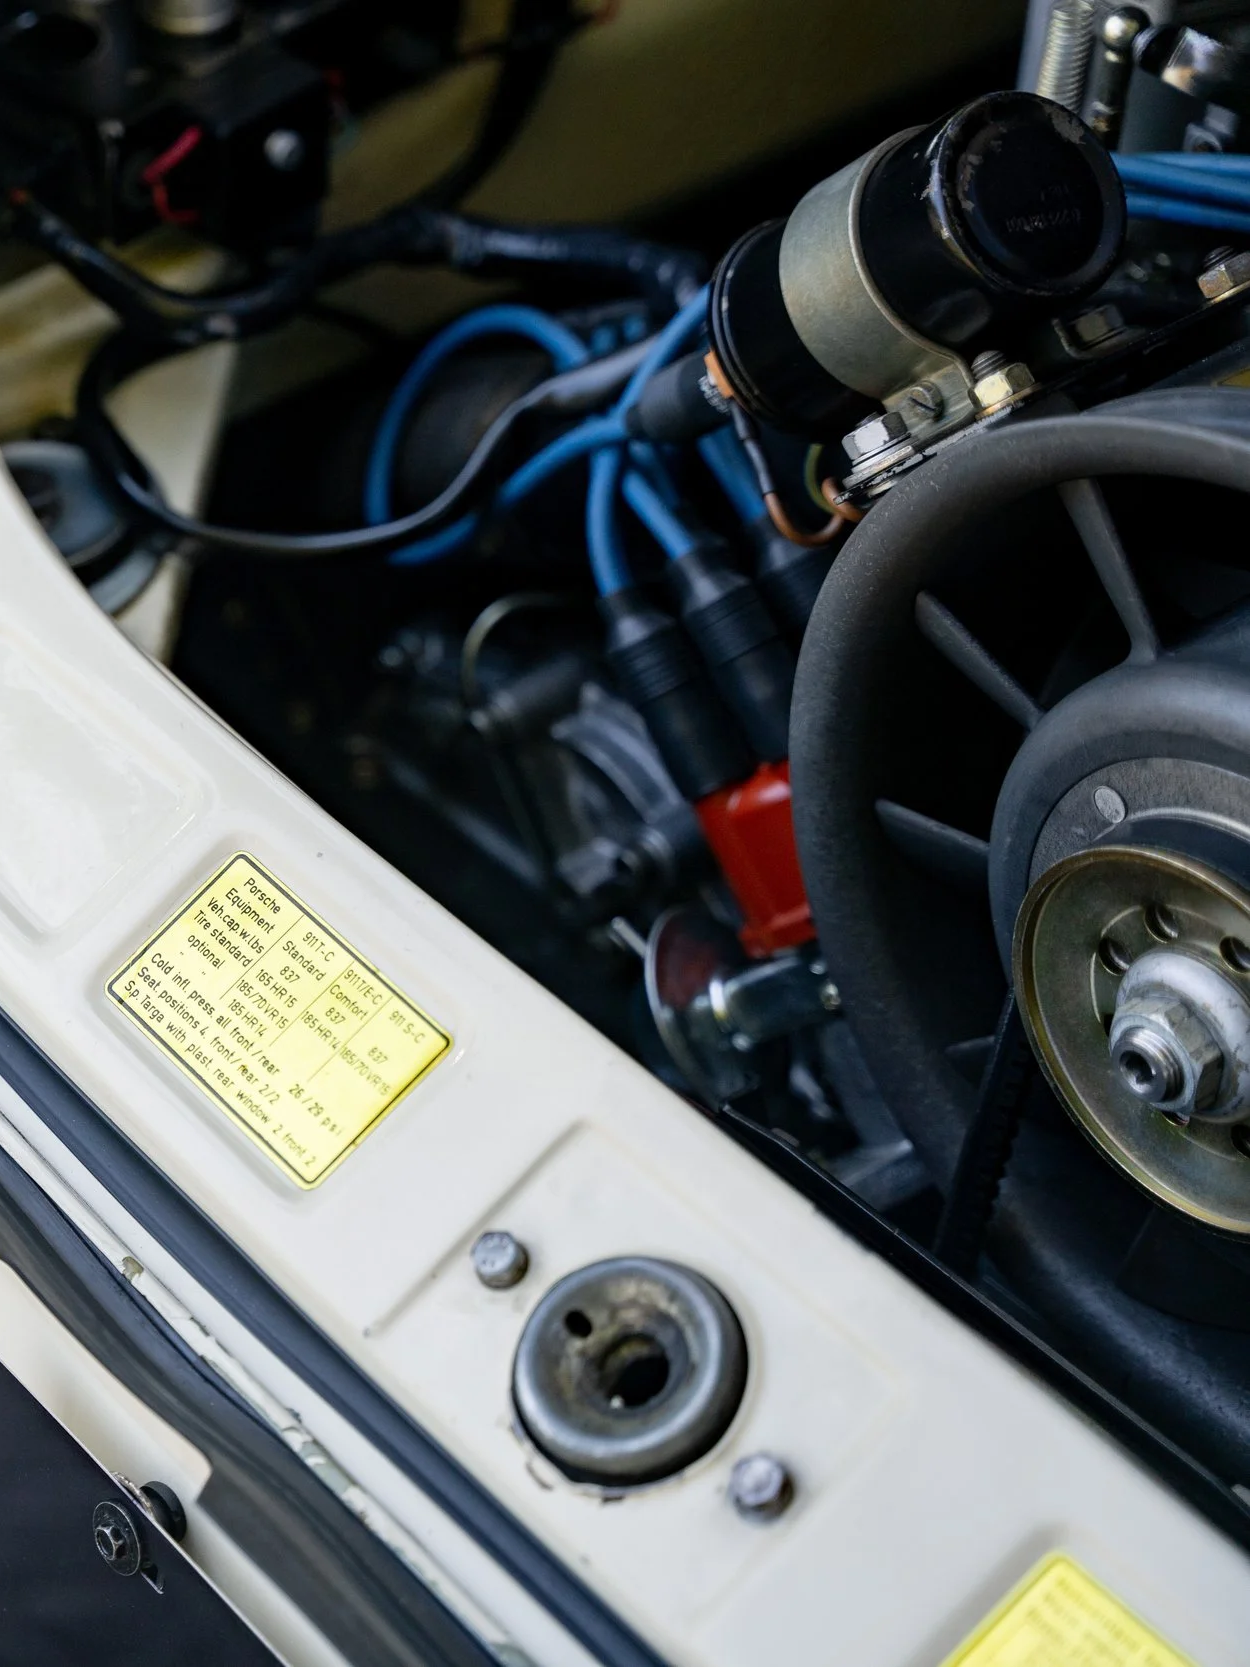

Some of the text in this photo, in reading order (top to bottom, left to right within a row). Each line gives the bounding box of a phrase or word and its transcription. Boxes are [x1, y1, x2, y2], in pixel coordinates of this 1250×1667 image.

[243, 877, 281, 915] Porsche
[187, 934, 226, 970] optional
[193, 909, 212, 931] Tire
[209, 928, 254, 968] standard
[224, 887, 369, 1021] Equipment Standard Comfort
[136, 966, 162, 993] Seat.
[157, 989, 201, 1030] positions
[150, 952, 175, 976] Cold
[171, 971, 191, 993] infl.
[186, 989, 216, 1019] press.
[215, 1015, 233, 1030] all
[229, 1026, 255, 1052] front
[257, 1055, 280, 1075] rear
[288, 1083, 305, 1099] 26
[307, 1101, 325, 1118] 29
[279, 965, 301, 984] 837
[324, 1006, 347, 1025] 837
[367, 1046, 389, 1065] 837
[139, 994, 165, 1024] Targa
[165, 1021, 187, 1044] with
[212, 1068, 235, 1089] rear
[235, 1089, 271, 1124] window
[271, 1123, 284, 1135] 2
[282, 1132, 308, 1159] front
[303, 1155, 317, 1168] 2
